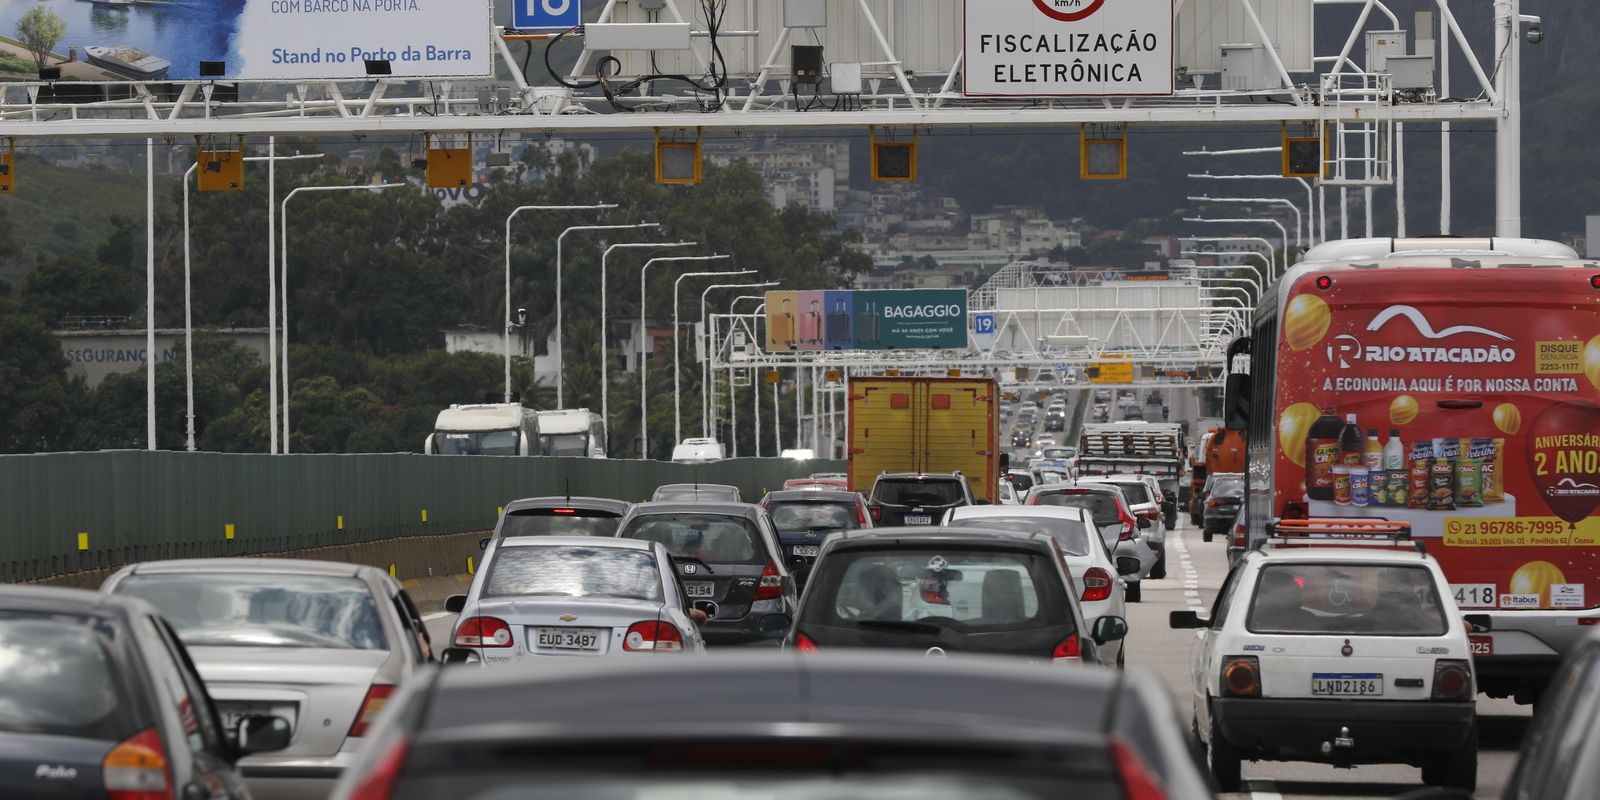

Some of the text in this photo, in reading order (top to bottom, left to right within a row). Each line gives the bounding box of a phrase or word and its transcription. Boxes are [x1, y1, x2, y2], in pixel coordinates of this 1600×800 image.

[271, 1, 300, 14] COM
[304, 0, 349, 13] BARCO
[353, 0, 371, 12] NA
[980, 29, 1157, 54] FISCALIZAÇÃO
[271, 46, 472, 64] Stand no Porto da Barra
[994, 58, 1142, 83] ELETRÔNICA
[884, 304, 961, 318] BAGAGGIO
[977, 318, 992, 332] 19
[67, 348, 157, 364] SEGURANÇ
[1366, 346, 1406, 362] RIO
[1407, 344, 1516, 363] ATACADÃO
[1540, 344, 1578, 353] DISQUE
[1540, 363, 1579, 371] 2253-1177
[1323, 375, 1578, 392] A ECONOMIA AQUI É POR NOSSA CONTA
[1481, 464, 1494, 472] AC
[1534, 450, 1600, 476] 2 ANO
[1464, 521, 1563, 535] 21 96786-7995
